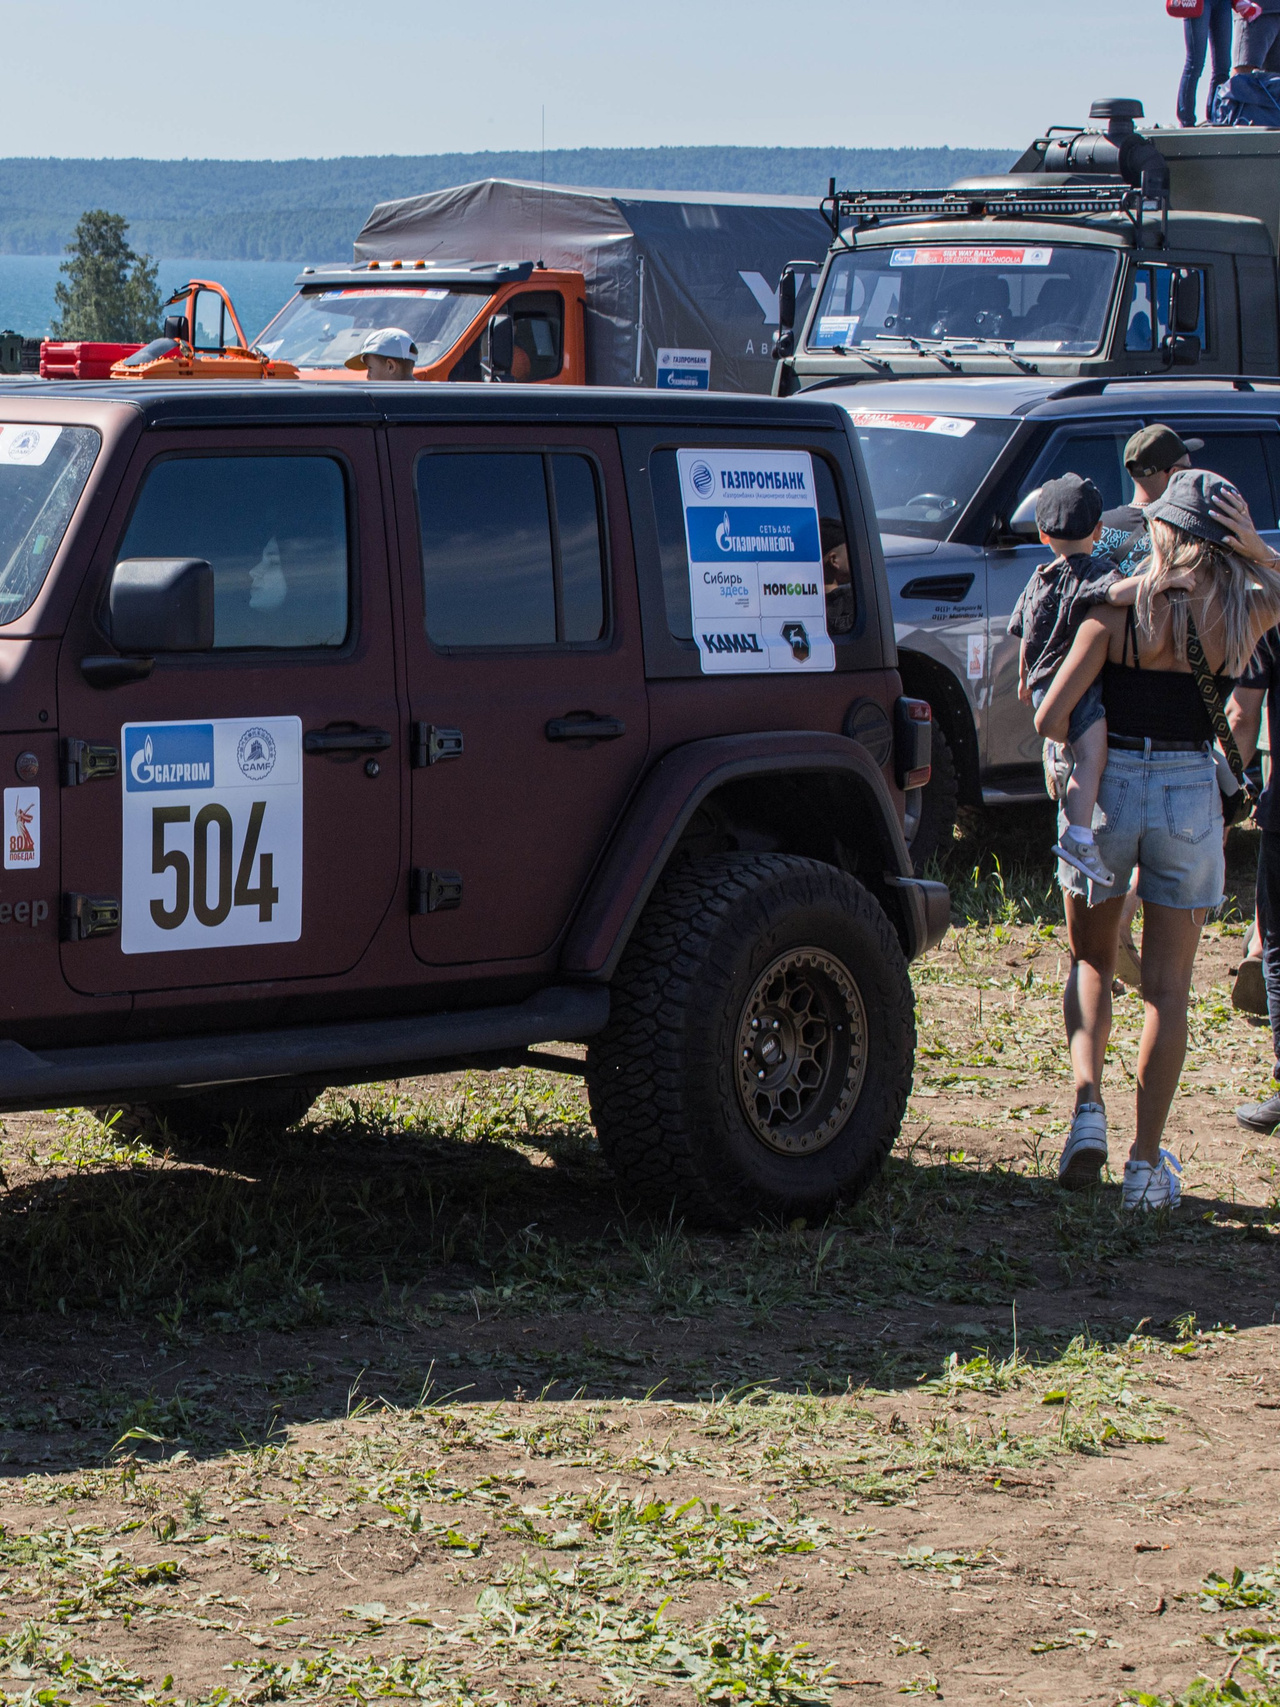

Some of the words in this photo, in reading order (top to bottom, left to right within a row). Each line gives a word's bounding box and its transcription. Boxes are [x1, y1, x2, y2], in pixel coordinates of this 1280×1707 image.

[672, 356, 707, 364] ГАЗПРОМБАНК
[721, 471, 806, 490] ГАЗПРОМБАНК
[759, 525, 777, 534] СЕТЬ
[777, 525, 791, 534] АЗС
[731, 536, 795, 552] ГАЗПРОМНЕФТЬ
[703, 571, 743, 587] Сибирь
[719, 585, 749, 598] здесь
[763, 583, 818, 596] MONGOLIA
[702, 633, 763, 654] KAMAZ
[154, 762, 211, 783] GAZPROM
[242, 762, 272, 772] CAMF
[9, 836, 24, 850] 80
[9, 852, 35, 861] ПОБЕДА!
[149, 801, 279, 931] 504
